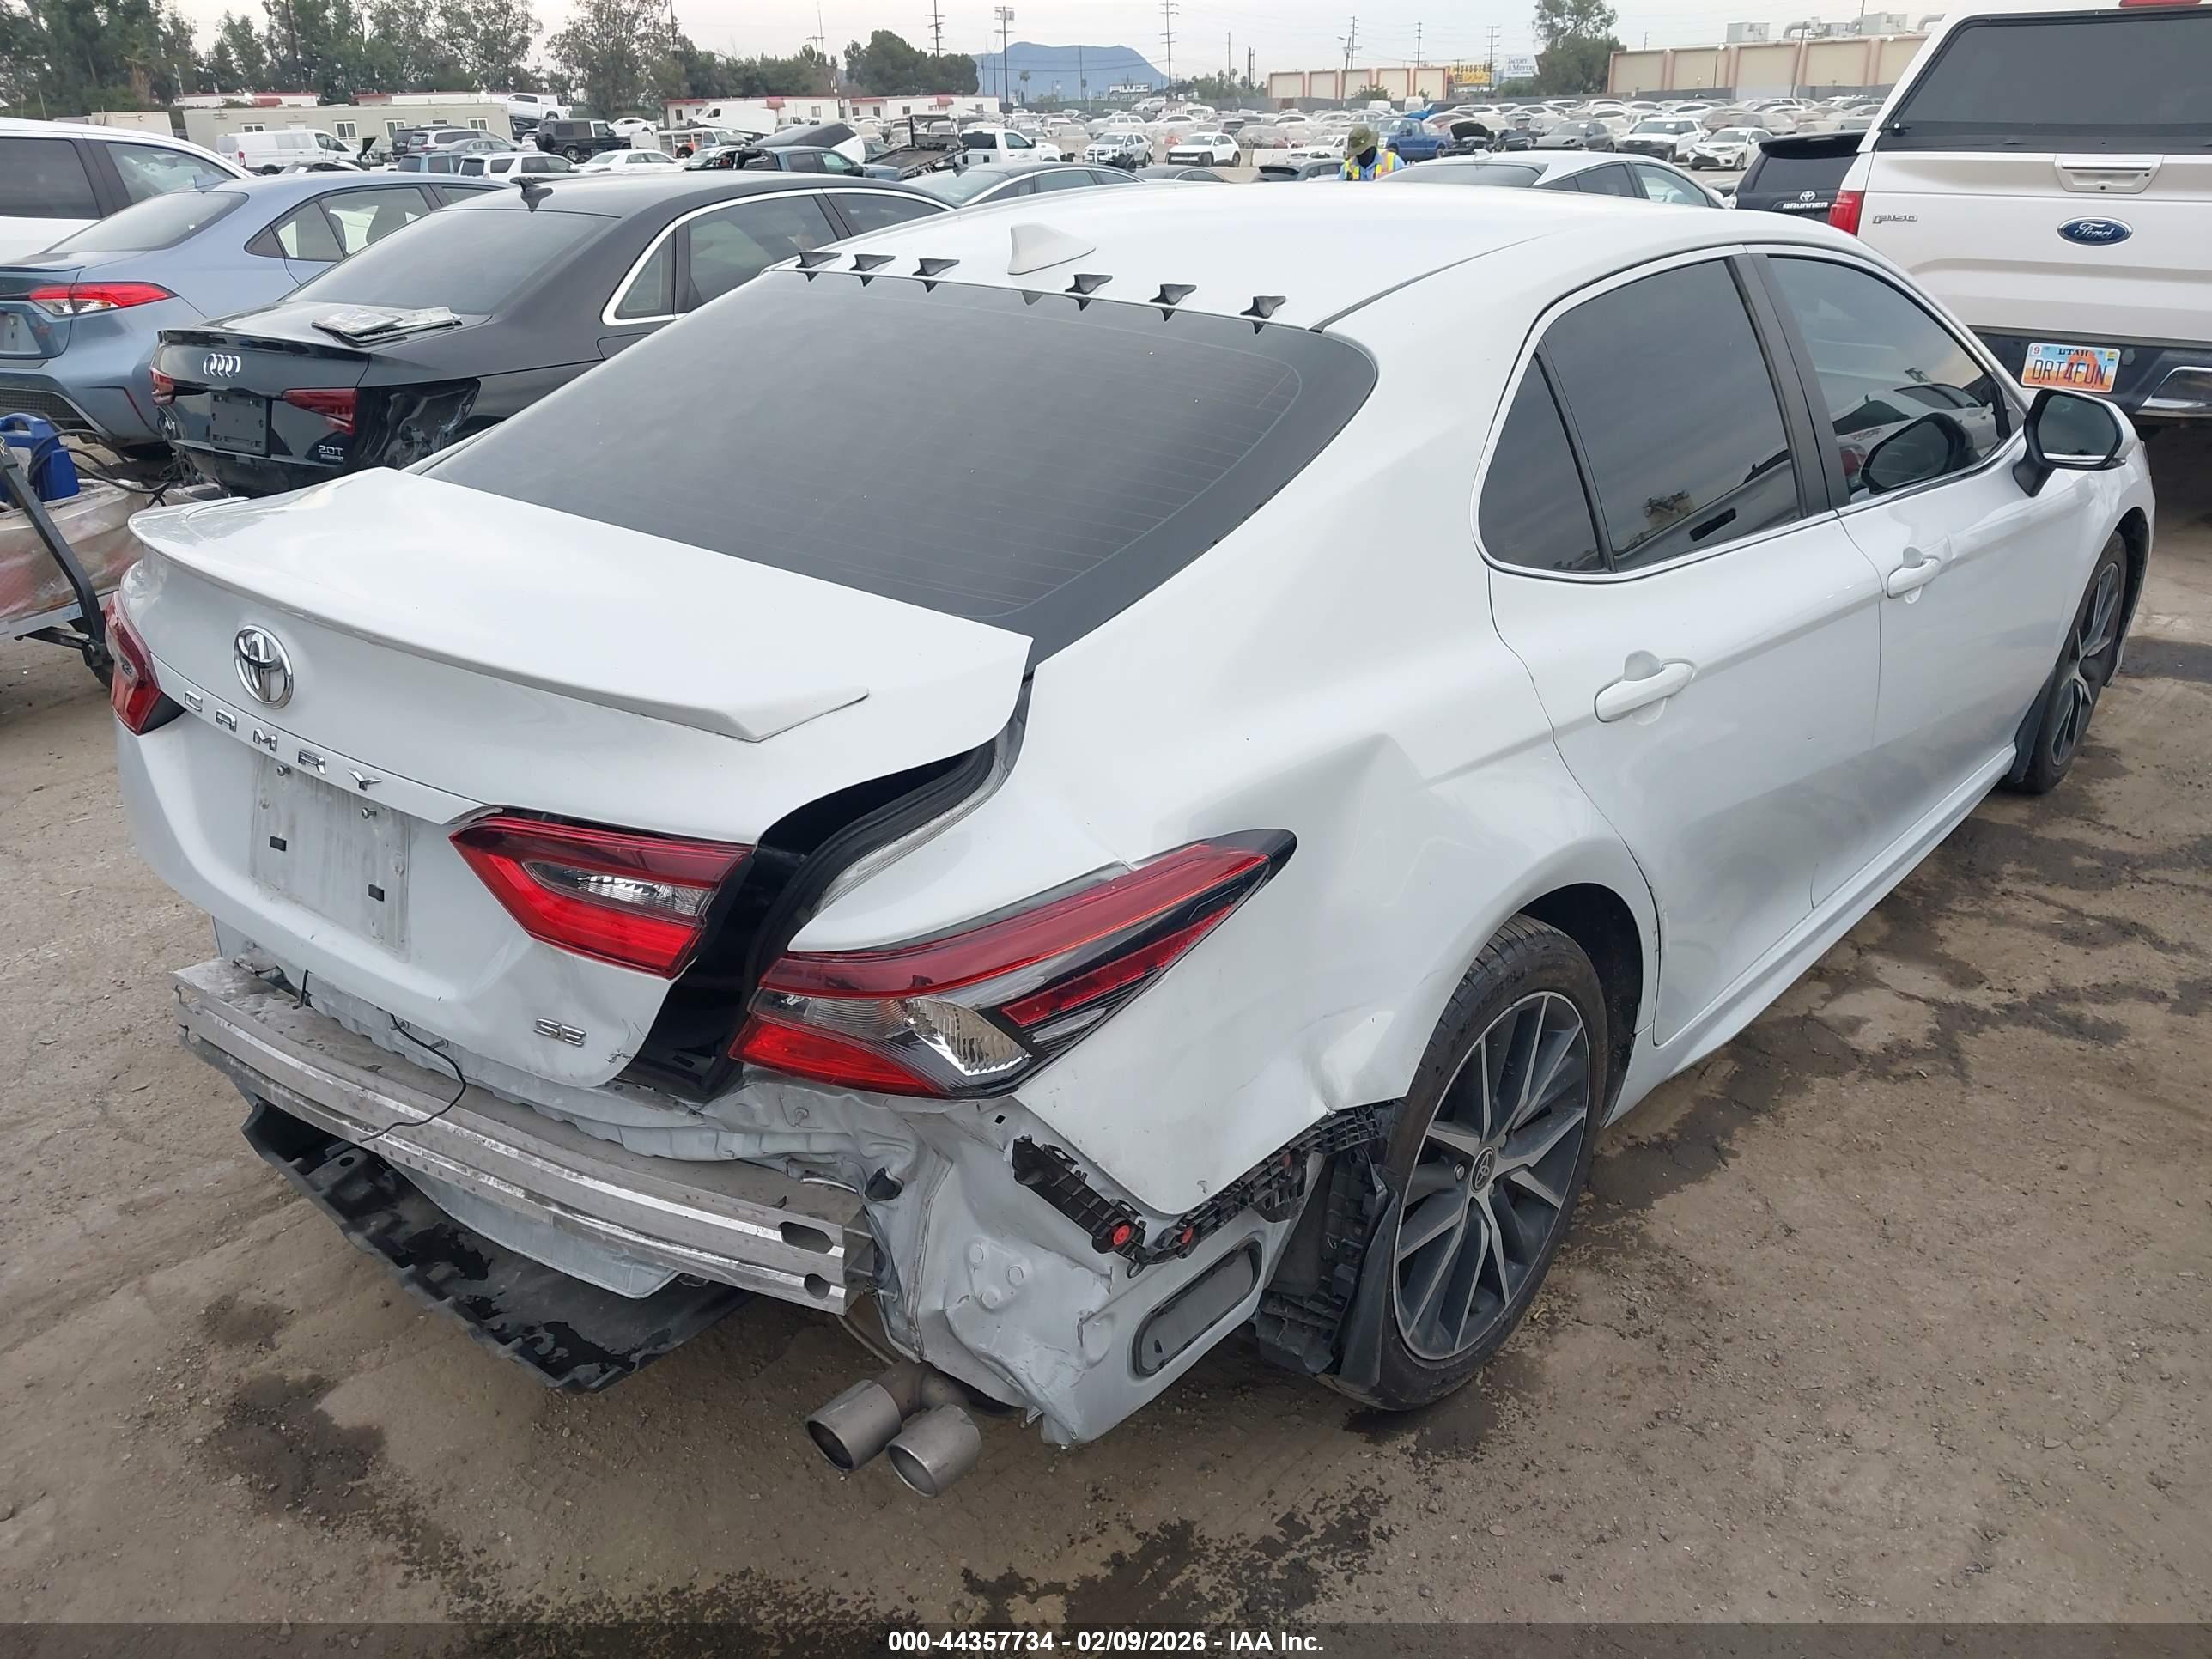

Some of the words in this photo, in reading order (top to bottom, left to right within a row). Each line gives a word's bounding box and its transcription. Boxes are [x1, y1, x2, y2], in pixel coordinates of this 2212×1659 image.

[2074, 222, 2116, 240] Ford
[2033, 346, 2040, 355] 9
[2058, 348, 2089, 357] UTAH
[2032, 359, 2107, 385] DRT4FUN
[184, 690, 383, 791] CAMRY
[533, 1017, 587, 1048] SE
